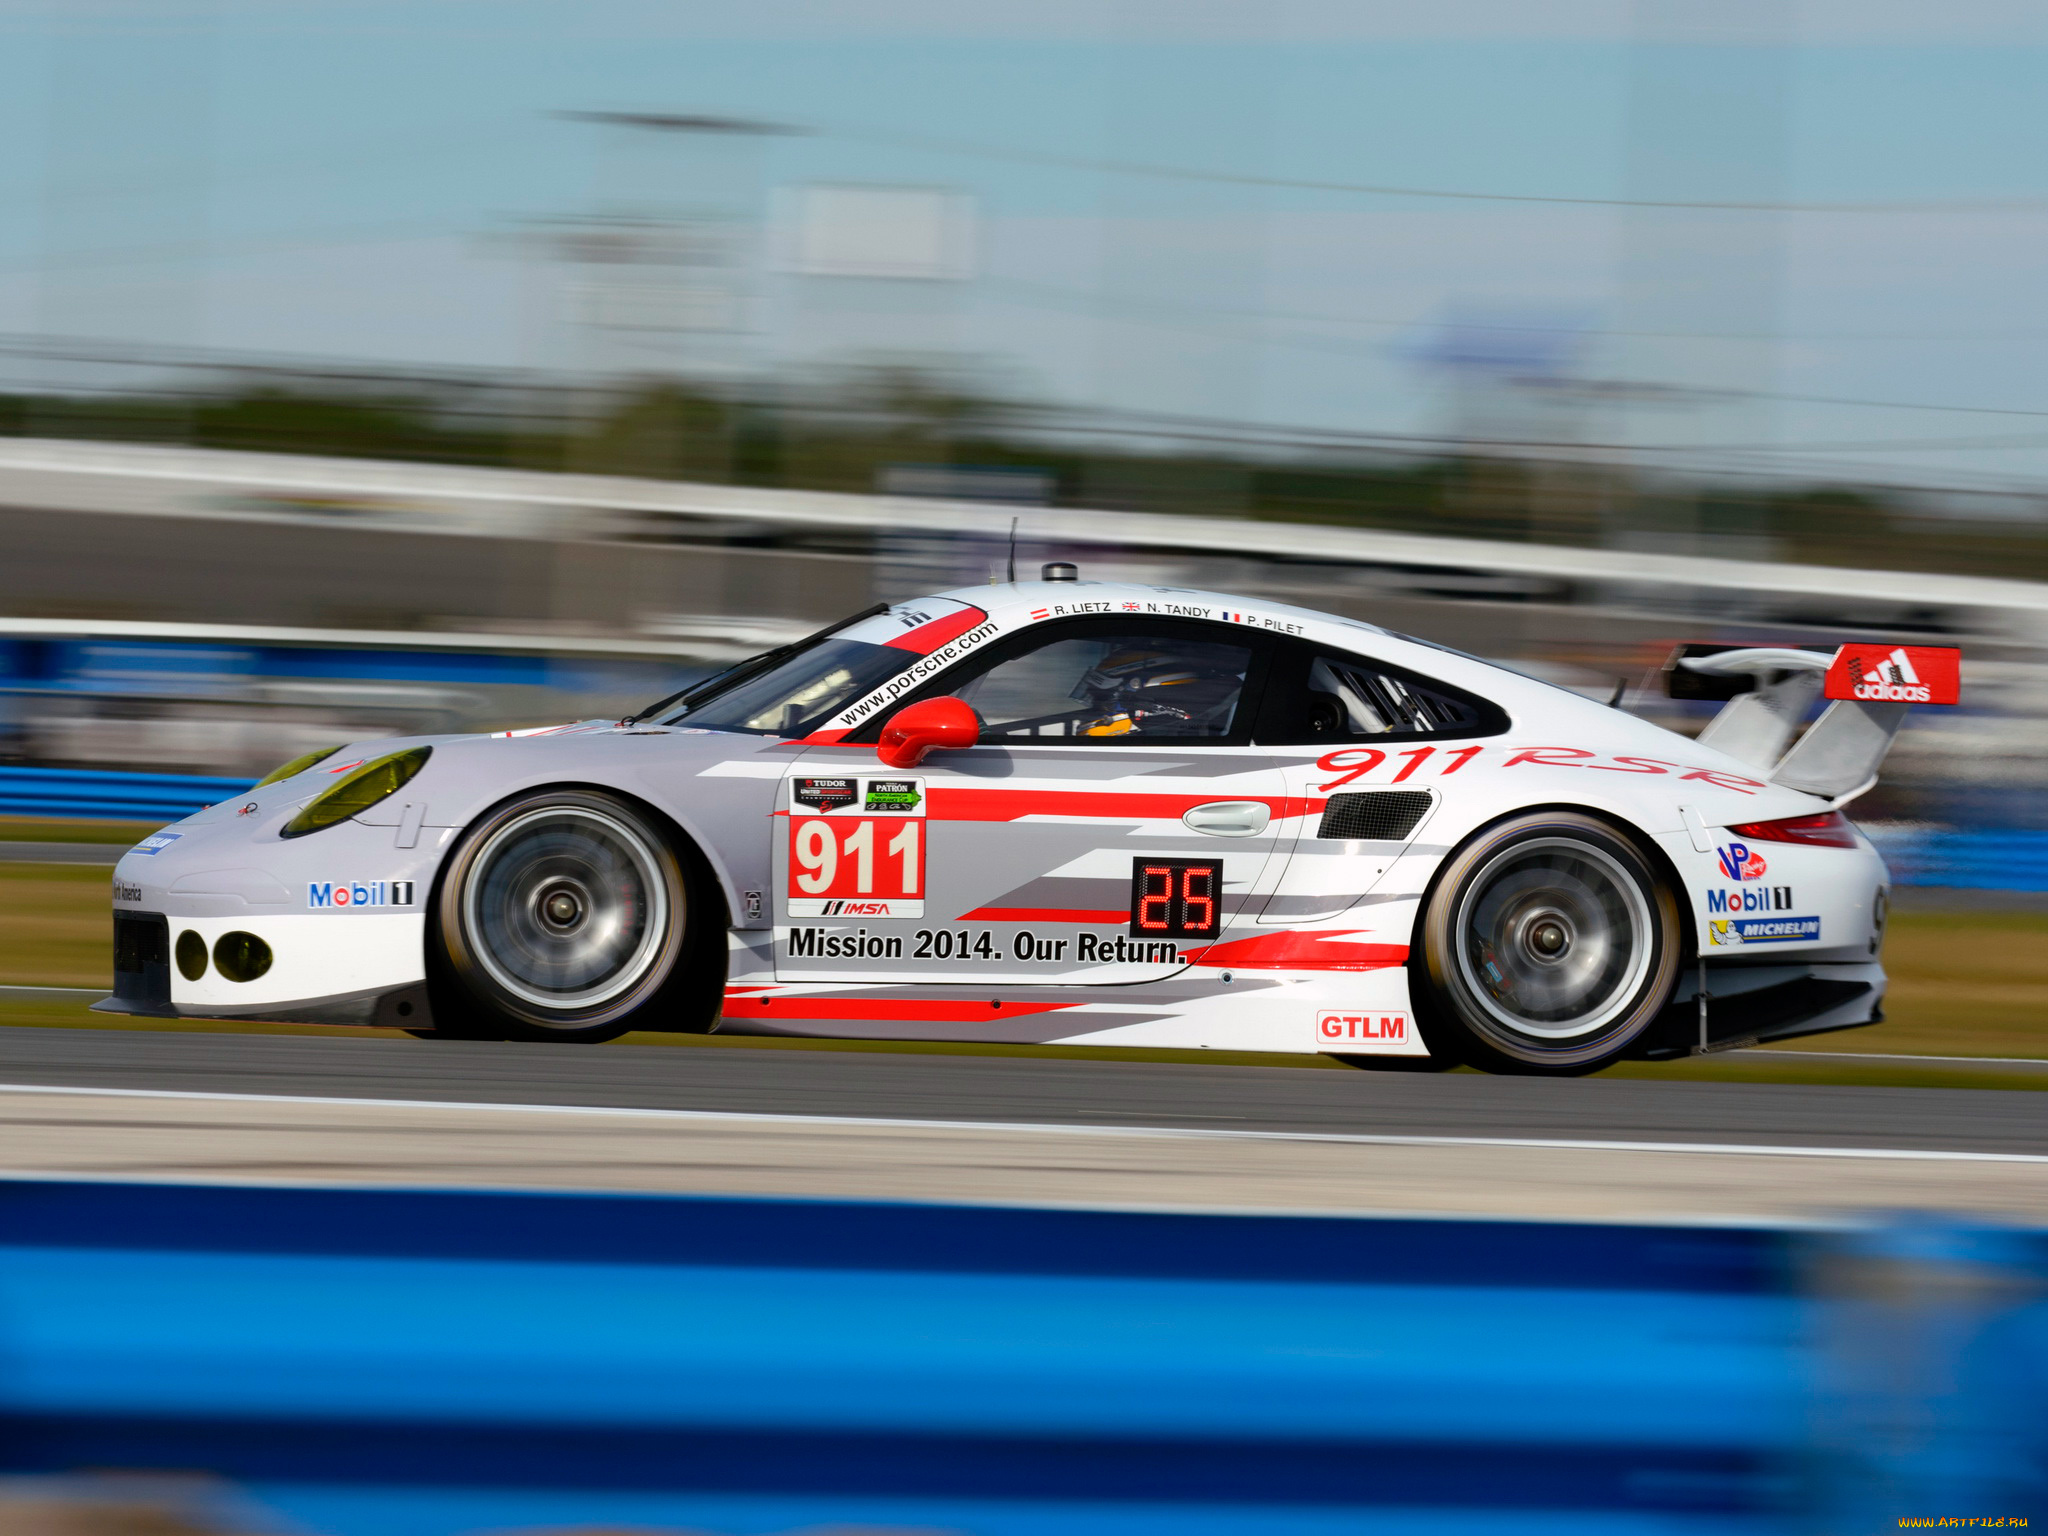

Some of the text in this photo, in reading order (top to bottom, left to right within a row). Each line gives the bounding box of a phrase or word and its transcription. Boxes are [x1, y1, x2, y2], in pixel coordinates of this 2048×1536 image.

[1054, 602, 1111, 615] R. LIETZ
[1147, 603, 1211, 618] N. TANDY
[1247, 615, 1304, 635] P. PILET
[1854, 682, 1931, 702] adidas
[1316, 745, 1767, 795] 911 RSR
[796, 820, 919, 894] 911
[1717, 843, 1749, 881] VP
[309, 881, 385, 908] Mobil
[1140, 867, 1213, 930] 25
[1707, 887, 1770, 913] Mobil
[843, 903, 891, 915] IMSA
[1743, 921, 1819, 936] MICHELIN
[787, 927, 1187, 964] Mission 2014. Our Return.
[1321, 1016, 1404, 1038] GTLM
